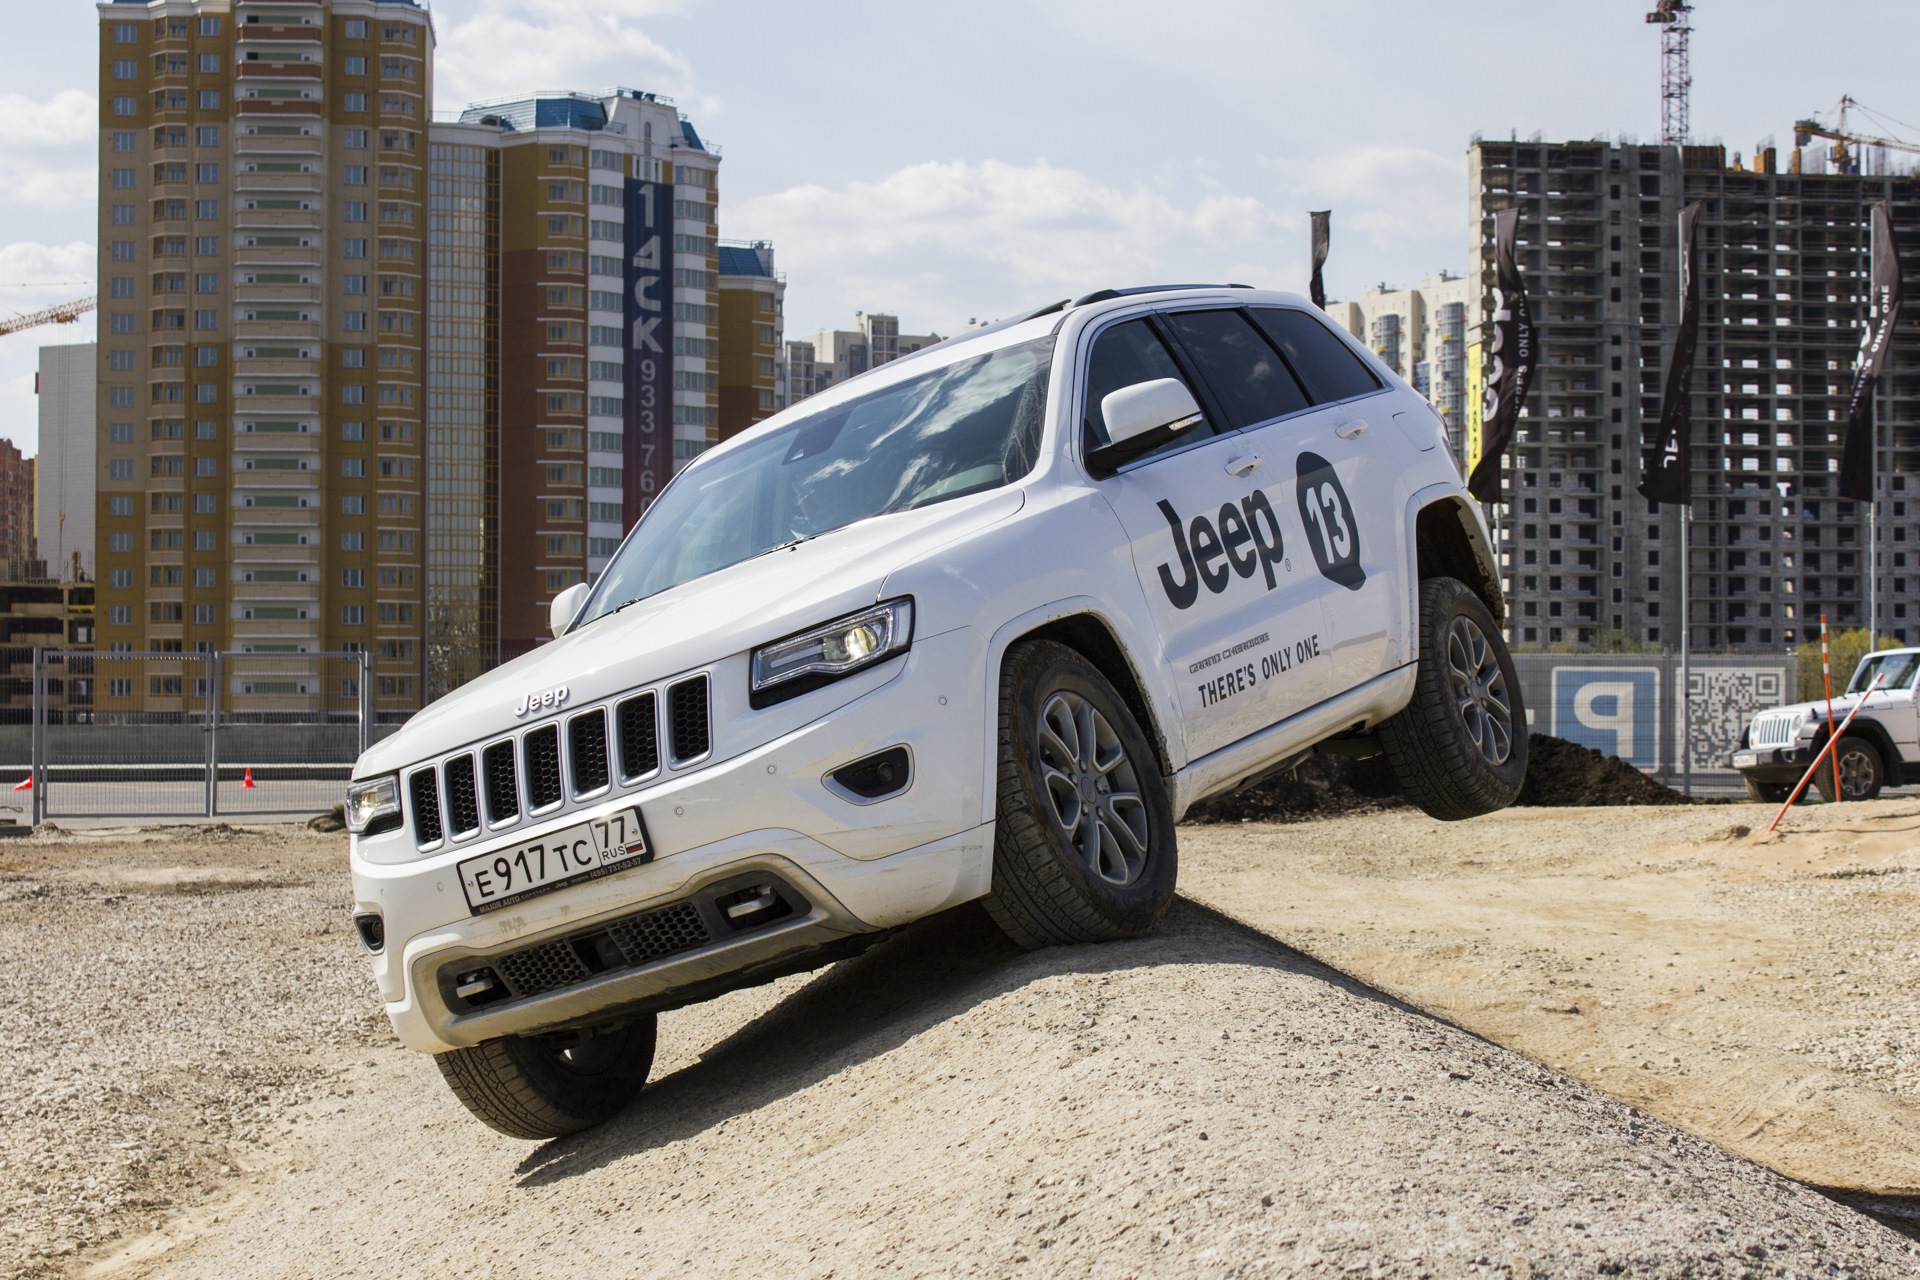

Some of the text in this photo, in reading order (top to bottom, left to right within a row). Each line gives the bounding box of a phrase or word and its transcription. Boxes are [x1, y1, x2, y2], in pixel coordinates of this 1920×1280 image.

[1518, 321, 1529, 358] ONLY
[1305, 482, 1351, 565] 13
[1156, 489, 1284, 610] Jeep
[1198, 634, 1320, 708] THERE'S ONLY ONE
[514, 685, 570, 717] Jeep
[595, 816, 625, 849] 77
[602, 846, 626, 861] RUS
[479, 901, 502, 914] MAJOR
[503, 895, 520, 907] AUTO
